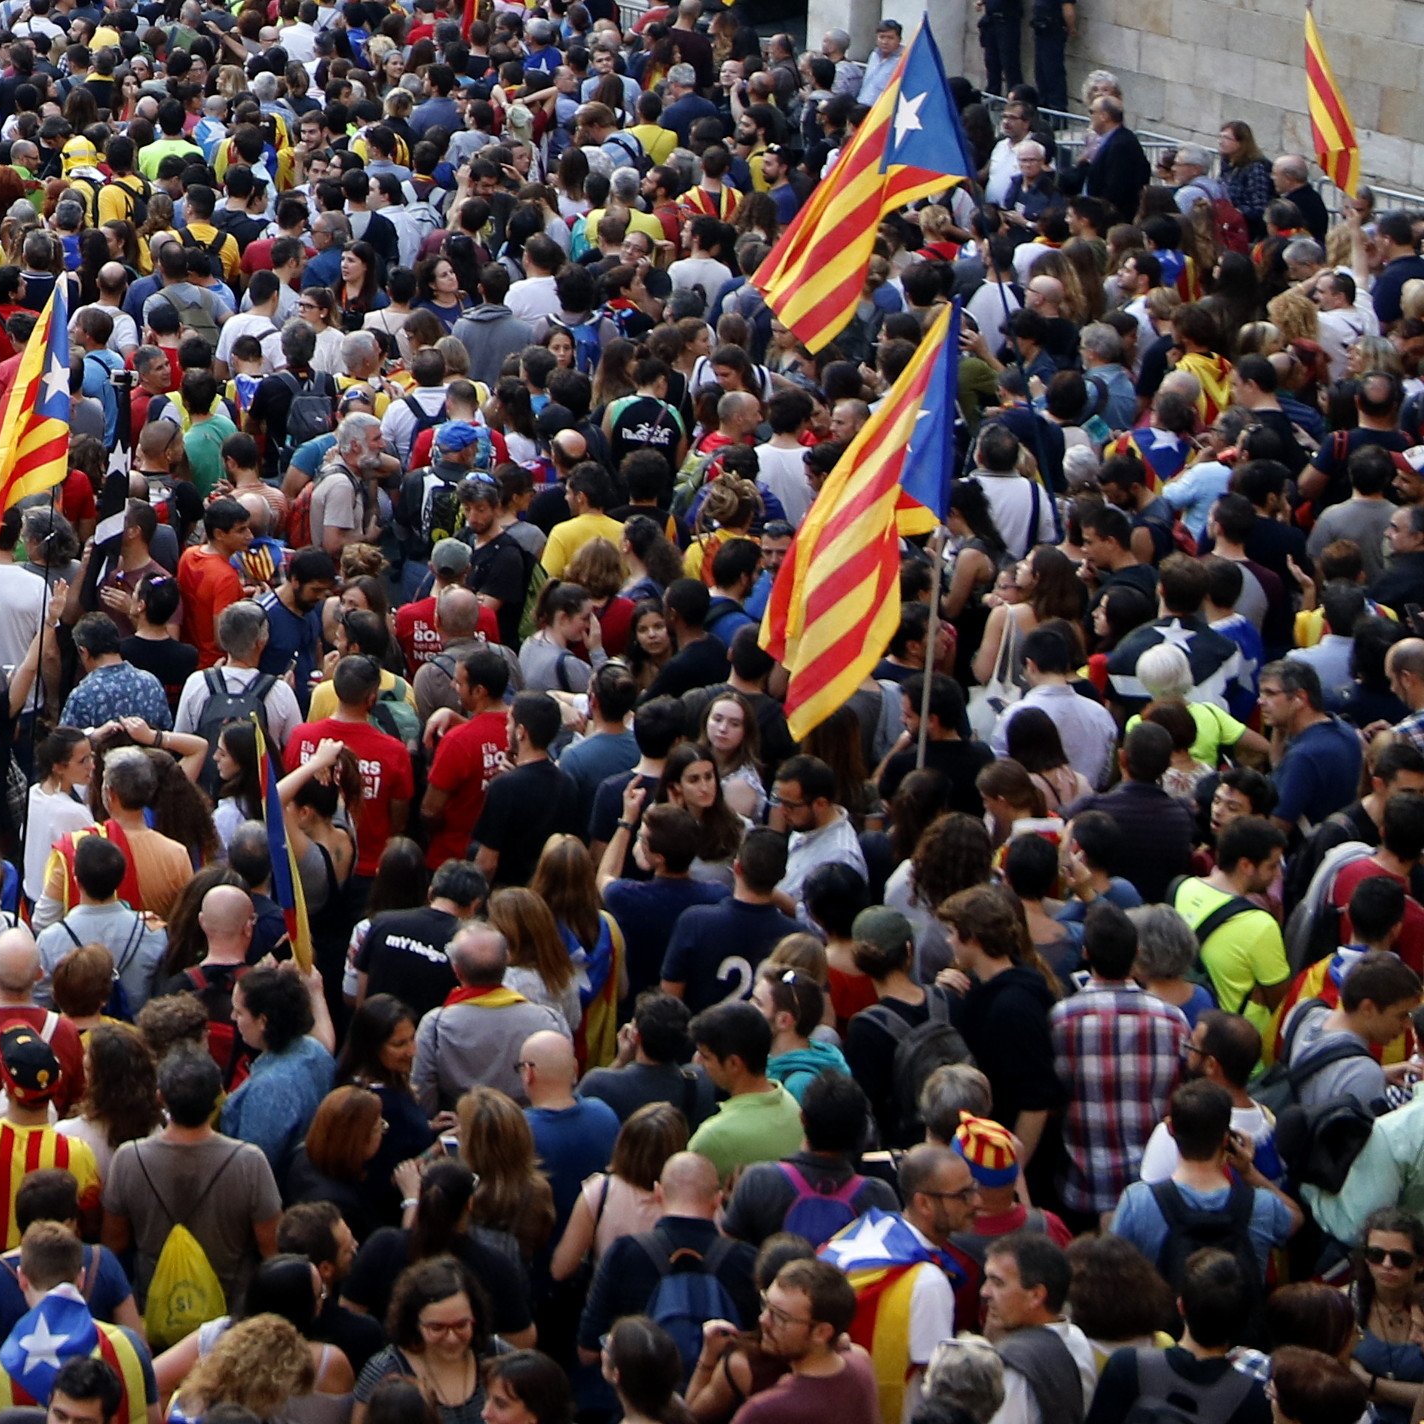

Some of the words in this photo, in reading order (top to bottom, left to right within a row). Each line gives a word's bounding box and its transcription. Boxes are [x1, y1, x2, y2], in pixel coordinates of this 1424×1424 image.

[413, 620, 429, 631] Els
[301, 740, 315, 753] Els
[481, 742, 498, 753] Els
